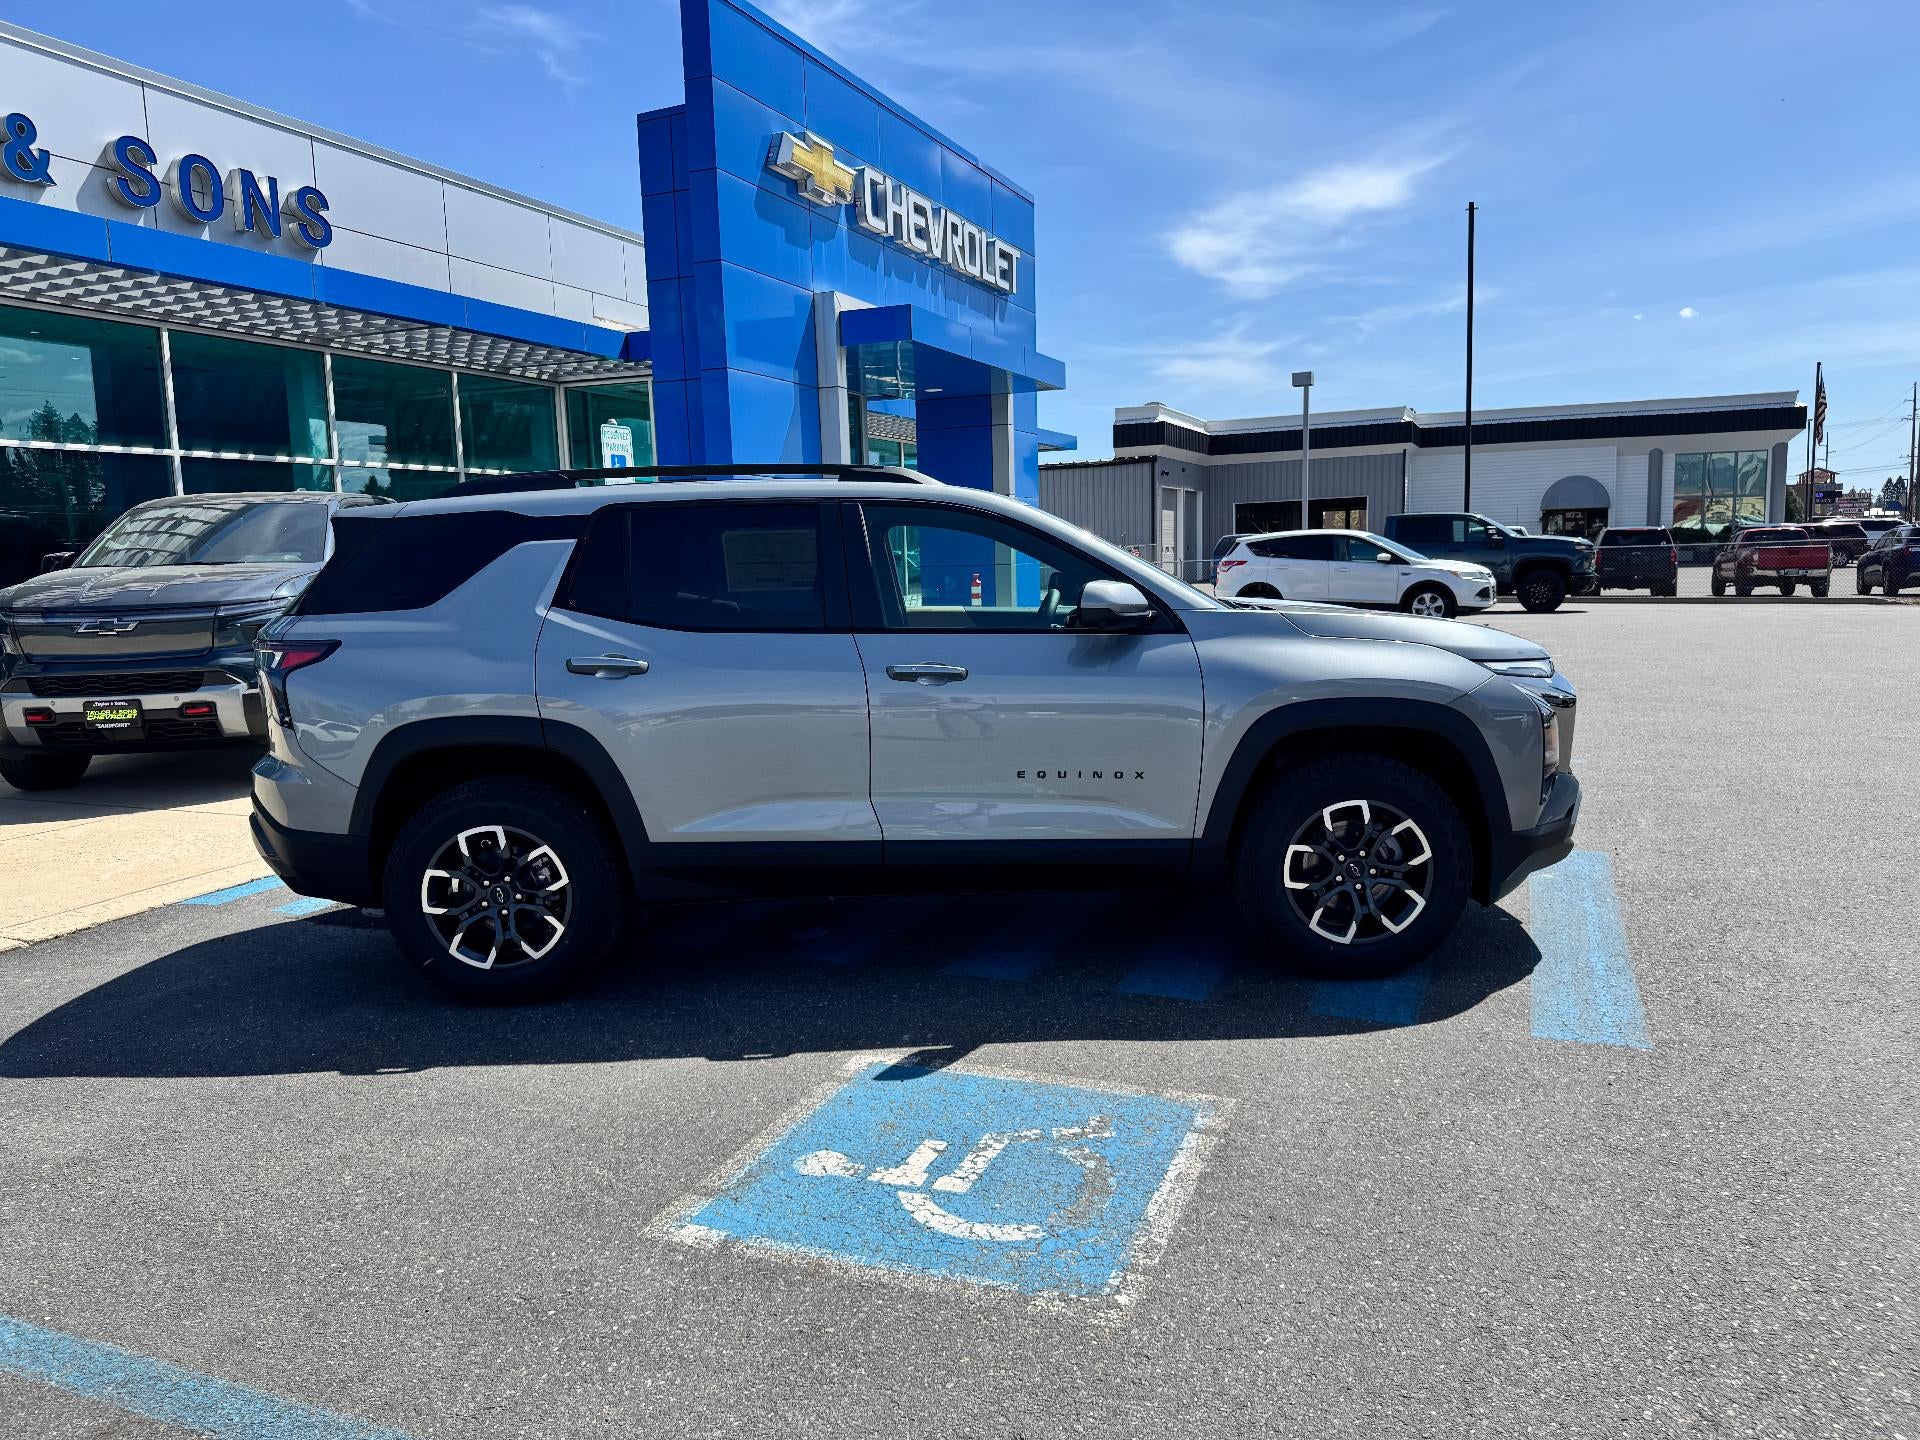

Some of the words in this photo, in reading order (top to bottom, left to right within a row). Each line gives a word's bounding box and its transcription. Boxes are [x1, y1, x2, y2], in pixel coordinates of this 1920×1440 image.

[0, 113, 57, 186] &
[106, 135, 333, 249] SONS
[851, 165, 1021, 295] CHEVROLET
[606, 443, 628, 452] PARKING
[1017, 770, 1145, 780] EQUINOX
